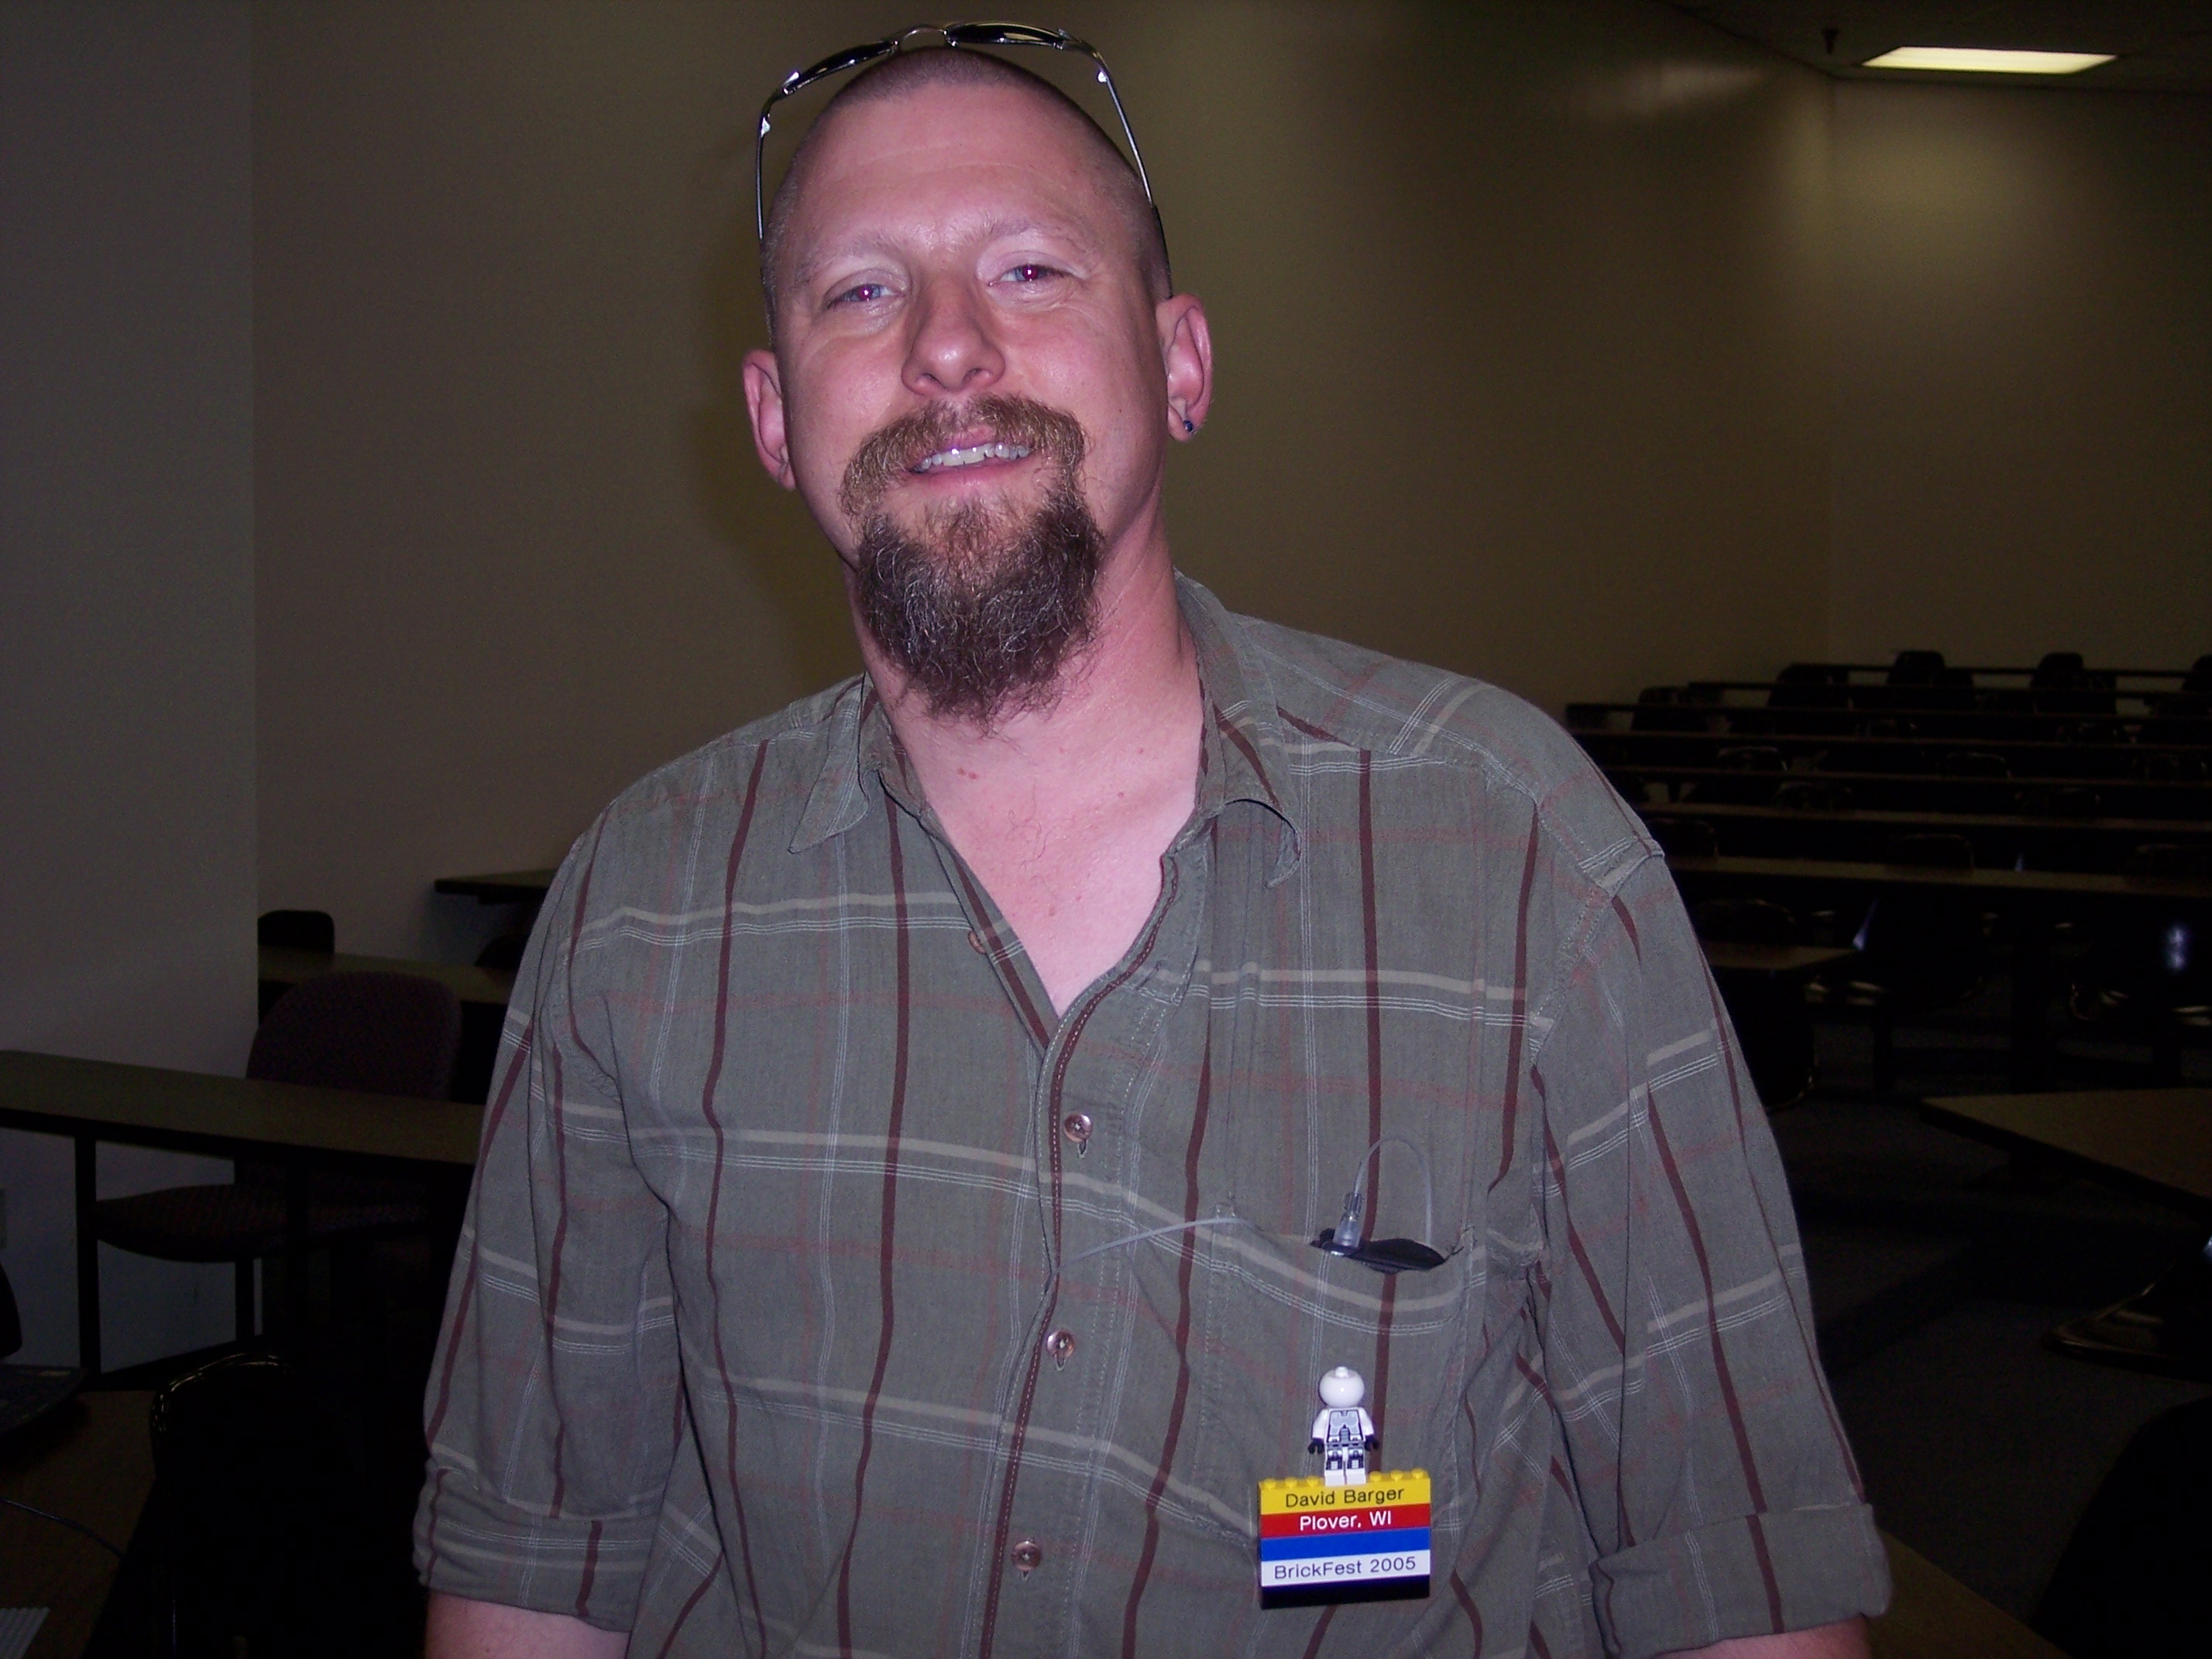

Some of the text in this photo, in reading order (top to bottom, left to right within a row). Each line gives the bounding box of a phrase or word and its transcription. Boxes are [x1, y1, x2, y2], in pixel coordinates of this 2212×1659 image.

[1286, 1488, 1405, 1508] David Barger
[1299, 1510, 1392, 1531] Plover, WI
[1274, 1556, 1416, 1579] BrickFest 2005
